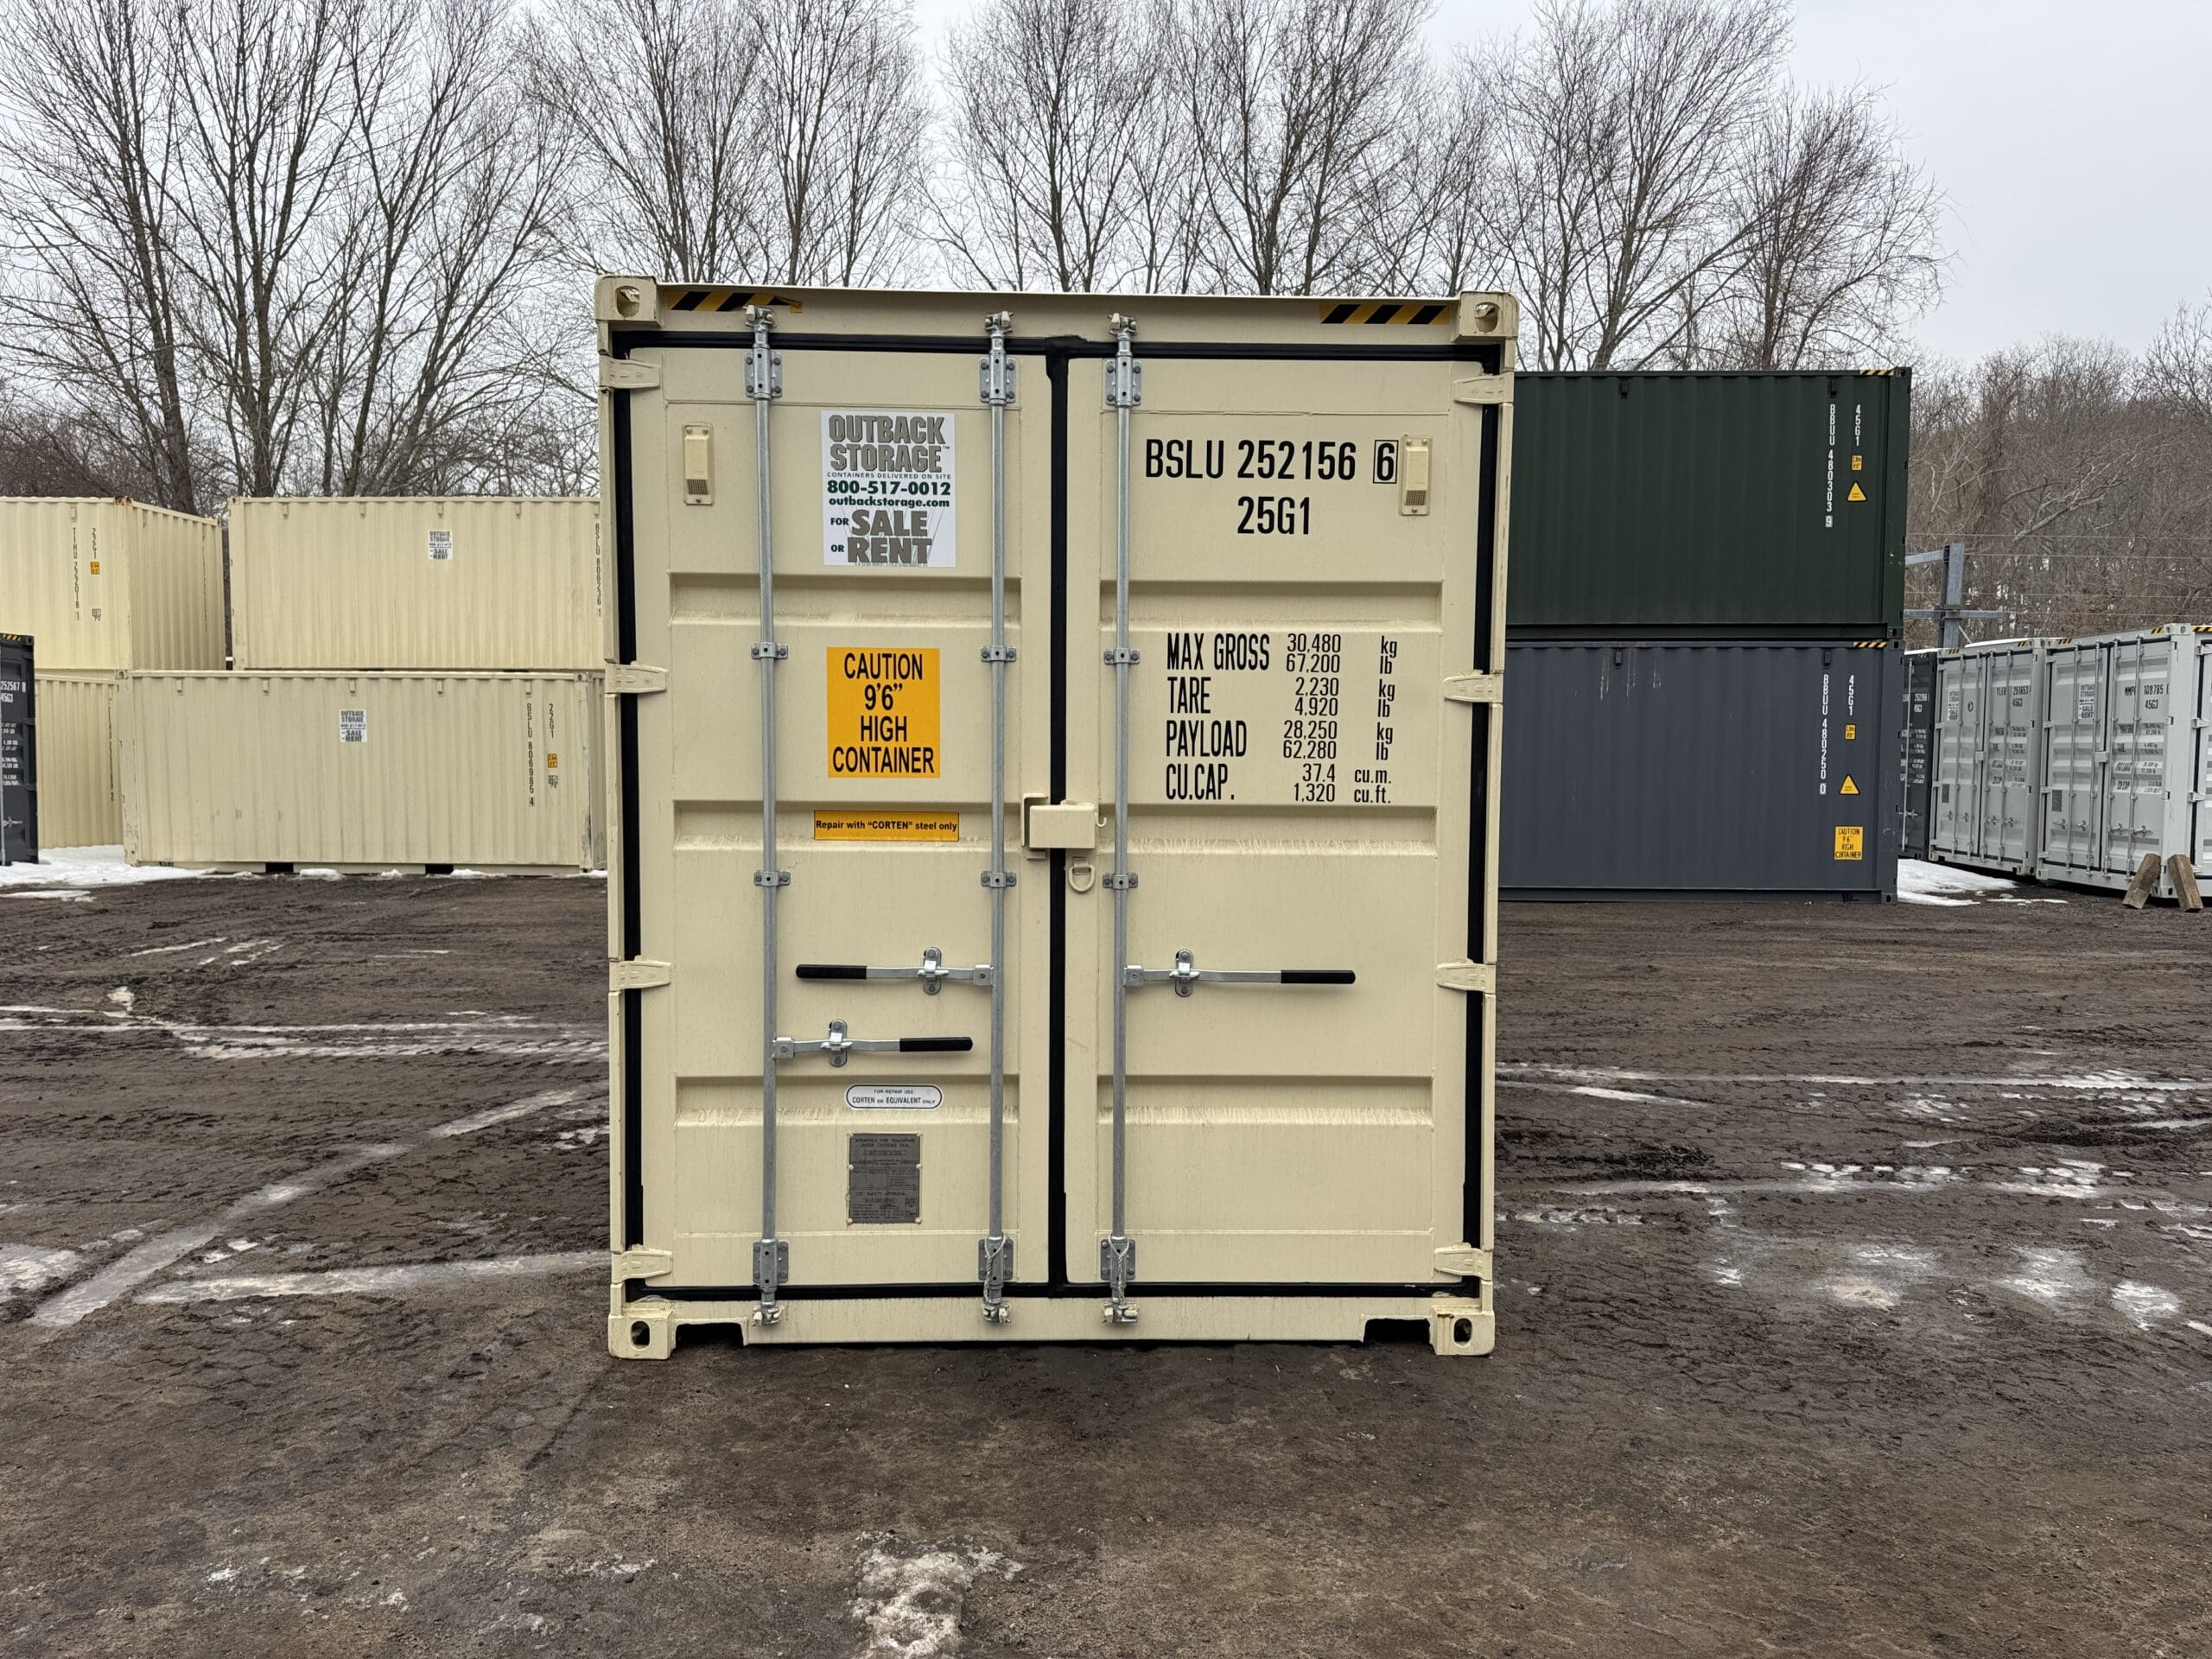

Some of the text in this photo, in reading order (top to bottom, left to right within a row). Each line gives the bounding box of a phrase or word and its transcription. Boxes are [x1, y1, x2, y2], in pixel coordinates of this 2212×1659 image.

[829, 415, 945, 444] OUTBACK
[830, 444, 942, 473] STORAGE
[1146, 439, 1395, 481] BSLU 252156 6
[827, 480, 950, 496] 800-517-0012
[829, 496, 950, 508] outbackstorage.com
[1237, 496, 1310, 534] 25G1
[830, 510, 928, 536] FOR SALE
[831, 537, 931, 563] OR RENT
[1166, 632, 1398, 671] MAX GROSS 30,480 kg
[1286, 653, 1393, 674] 67,200 lb
[843, 652, 923, 679] CAUTION
[1166, 677, 1395, 714] TARE 2,230 kg
[1294, 696, 1390, 717] 4,920 lb
[861, 715, 907, 742] HIGH
[1166, 720, 1393, 757] PAYLOAD 28,250 kg
[832, 747, 935, 773] CONTAINER
[1282, 740, 1389, 760] 62,280 lb
[1302, 763, 1336, 783] 37.4
[1354, 769, 1391, 784] cu.m.
[1294, 783, 1391, 804] 1,320 cu.ft.
[816, 821, 843, 830] Repair
[938, 822, 957, 831] only
[1835, 850, 1861, 859] CONTAINER
